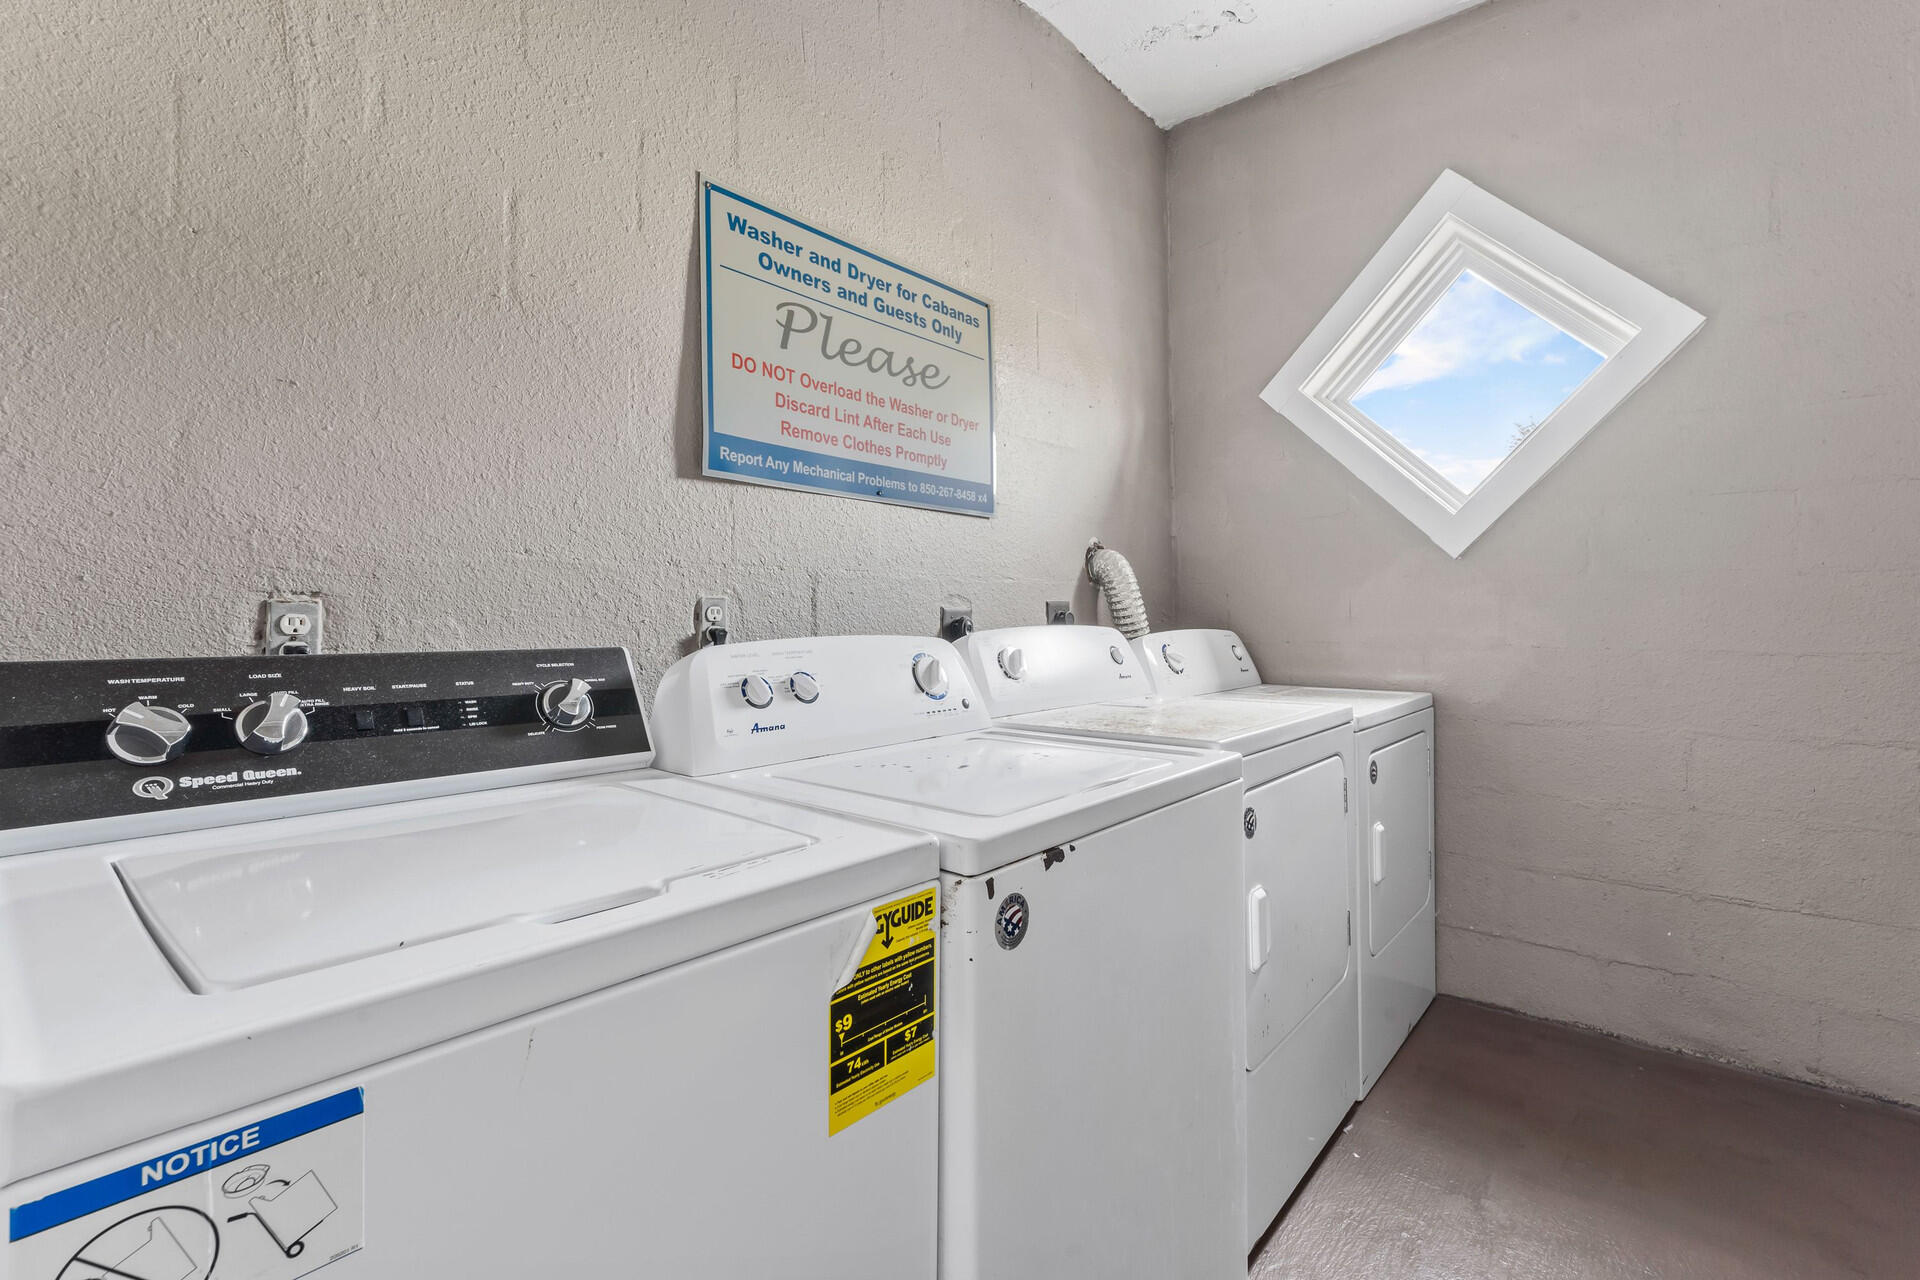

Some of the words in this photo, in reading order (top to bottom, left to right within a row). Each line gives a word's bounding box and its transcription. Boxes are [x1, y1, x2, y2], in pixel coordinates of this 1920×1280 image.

[727, 212, 803, 257] Washer
[809, 249, 841, 274] and
[848, 262, 892, 293] Dryer
[896, 283, 917, 303] for
[922, 294, 980, 328] Cabanas
[758, 252, 831, 294] Owners
[837, 286, 868, 307] and
[873, 299, 927, 329] Guests
[932, 318, 962, 344] Only
[775, 301, 950, 389] Please
[731, 352, 756, 373] DO
[762, 361, 795, 385] NOT
[800, 372, 862, 402] Overload
[865, 390, 886, 408] the
[889, 397, 933, 422] Washer
[936, 411, 948, 423] or
[951, 413, 979, 433] Dryer
[775, 392, 830, 419] Discard
[834, 406, 860, 427] Lint
[863, 415, 894, 434] After
[898, 423, 927, 442] Each
[930, 431, 951, 447] Use
[780, 420, 839, 447] Remove
[842, 435, 892, 458] Clothes
[895, 445, 948, 471] Promptly
[719, 446, 763, 470] Report
[765, 455, 790, 475] Any
[793, 460, 855, 484] Mechanical
[857, 471, 906, 492] Problems
[908, 481, 918, 493] to
[977, 492, 988, 503] x4
[751, 722, 786, 734] Amana
[179, 772, 238, 789] Speed
[212, 781, 244, 790] Commercial
[903, 972, 913, 980] Cost
[835, 1013, 853, 1033] $9
[904, 1025, 918, 1042] $7
[847, 1056, 861, 1074] 74
[141, 1126, 261, 1187] NOTICE
